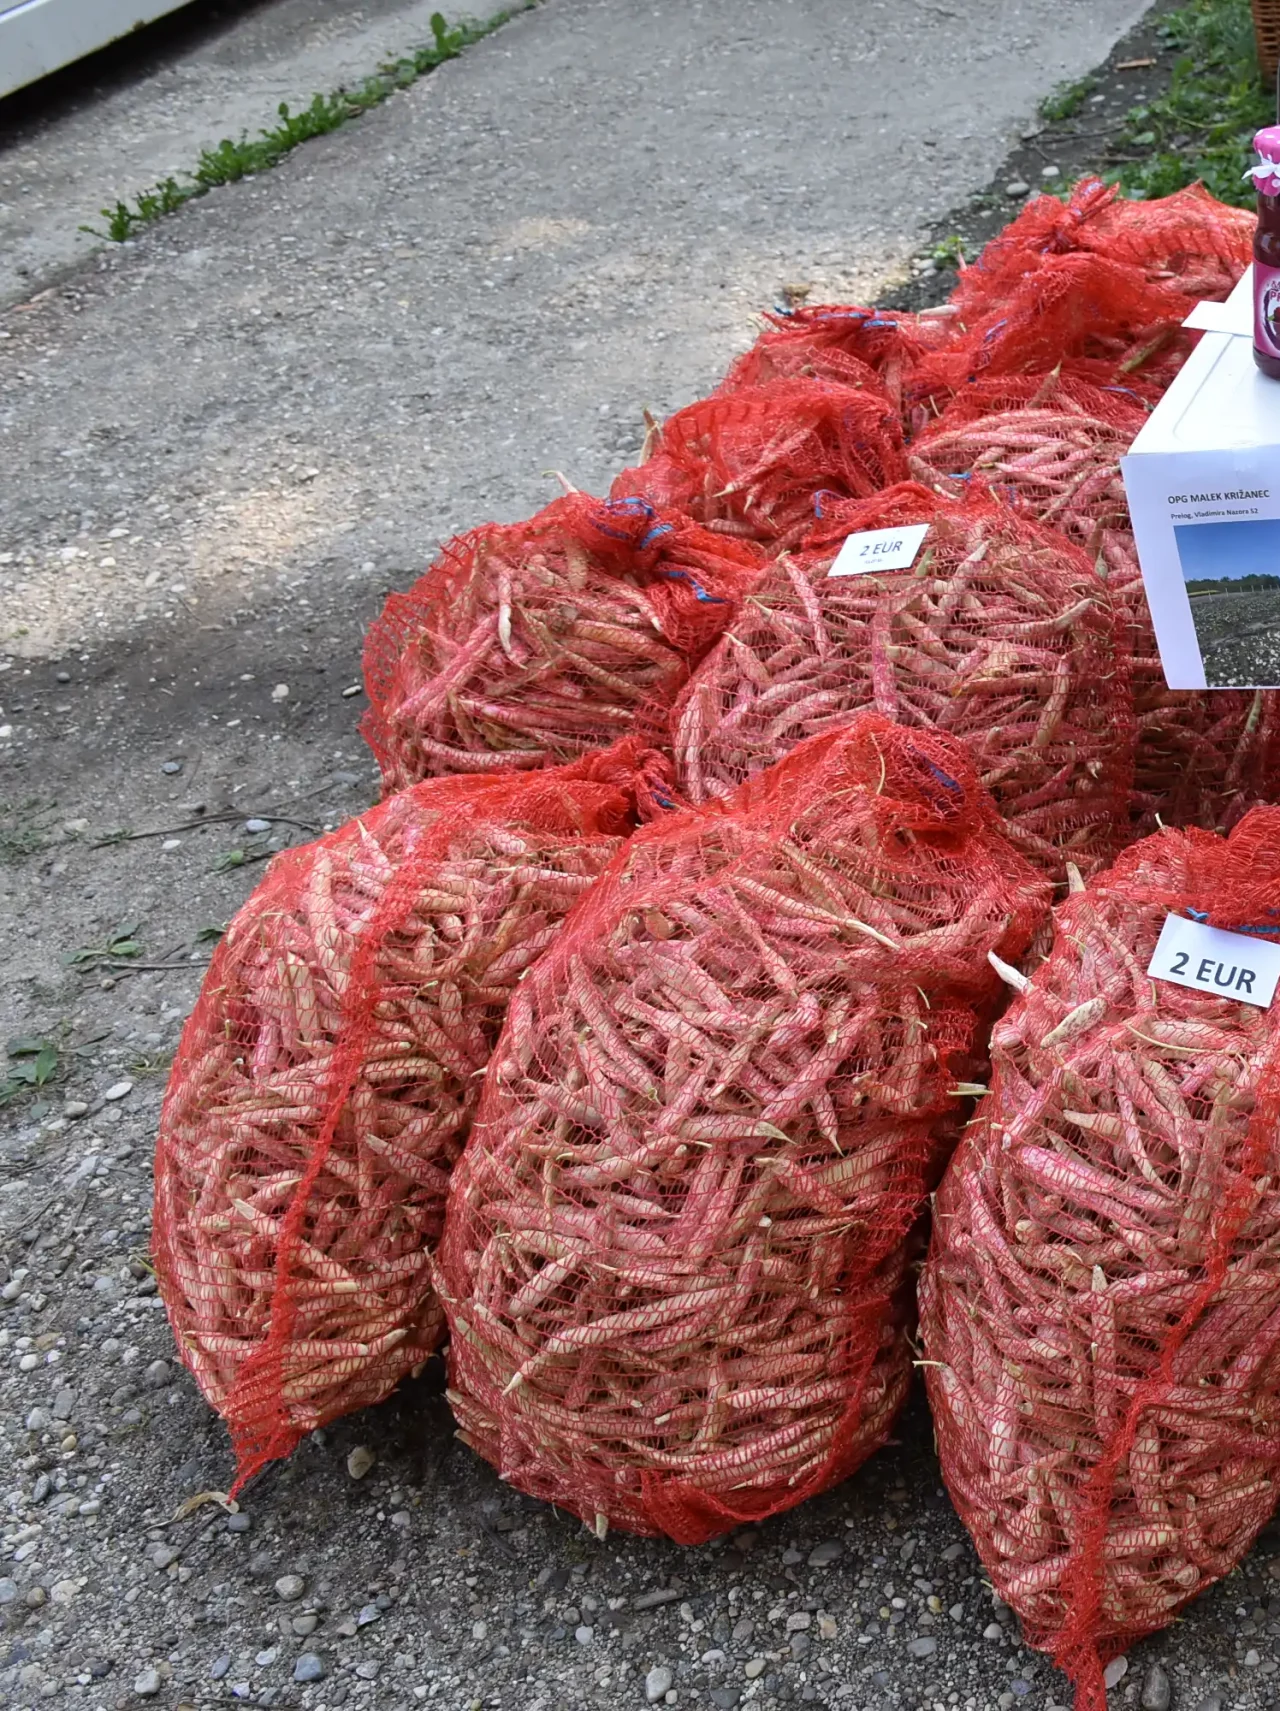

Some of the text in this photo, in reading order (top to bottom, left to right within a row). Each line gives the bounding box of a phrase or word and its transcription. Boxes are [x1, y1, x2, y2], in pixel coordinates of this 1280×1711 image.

[1167, 489, 1270, 505] OPG MALEK KRIŽANEC
[1171, 512, 1194, 521] Prelog,
[1194, 510, 1226, 518] Vladimira
[859, 540, 903, 557] 2 EUR
[1169, 951, 1257, 994] 2 EUR
